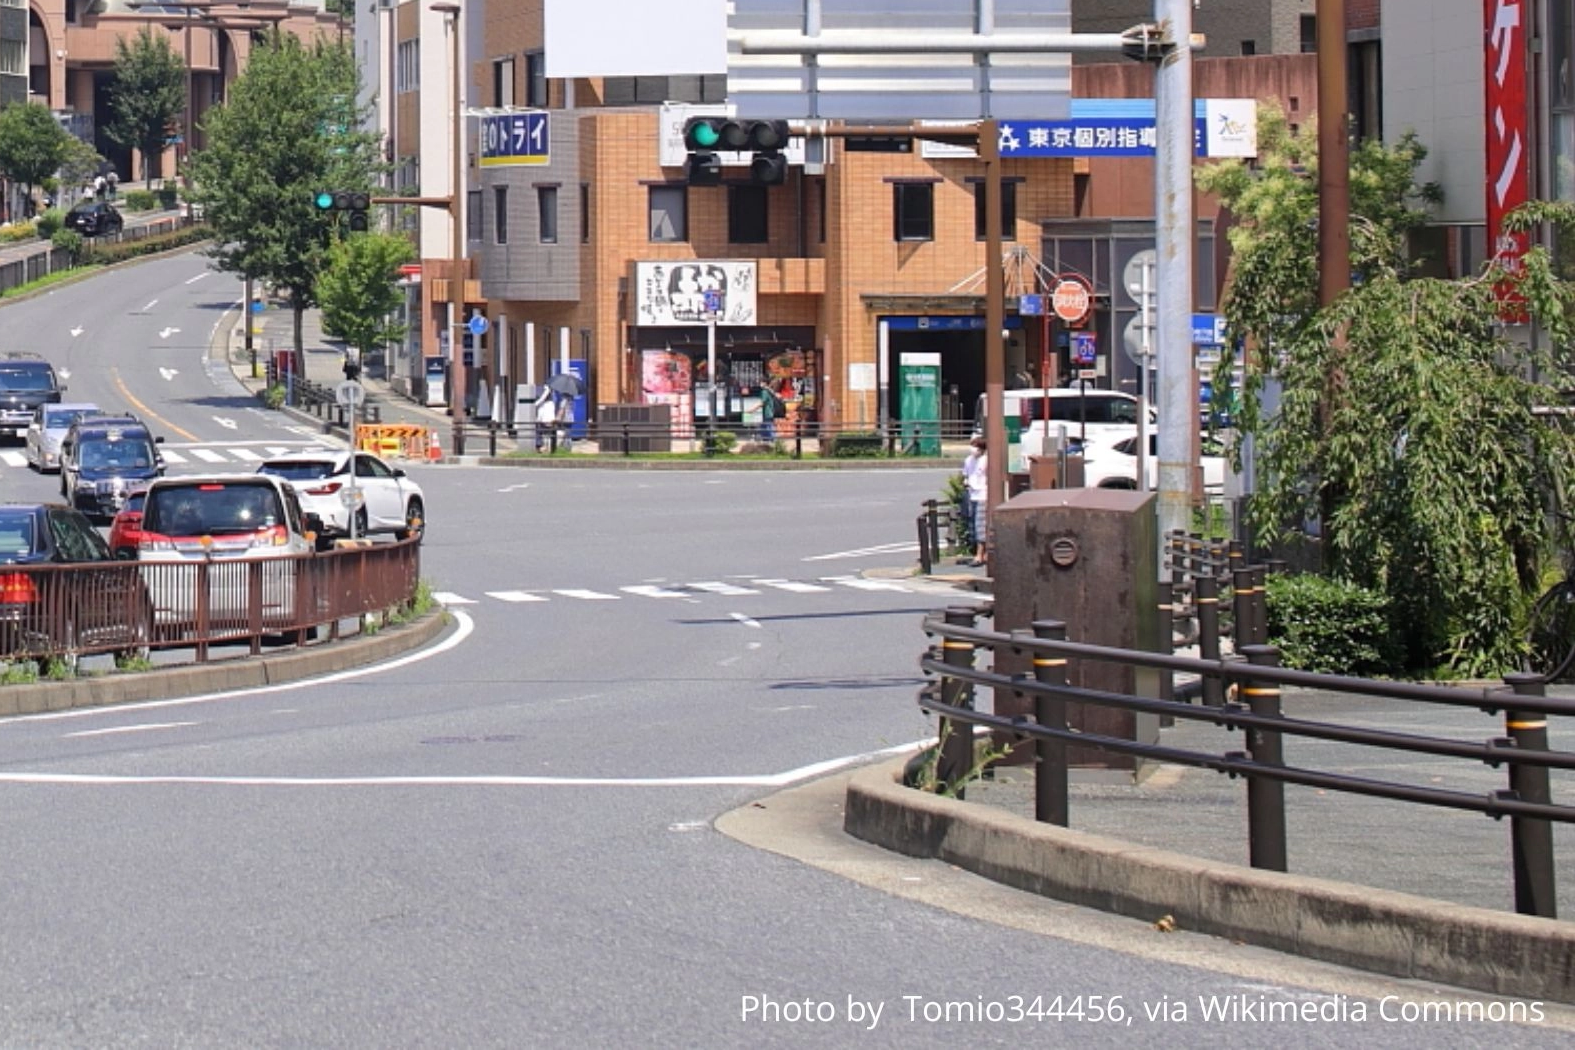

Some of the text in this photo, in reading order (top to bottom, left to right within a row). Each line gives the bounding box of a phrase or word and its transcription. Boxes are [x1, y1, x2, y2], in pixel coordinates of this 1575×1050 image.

[1028, 127, 1201, 149] 東京個別指導
